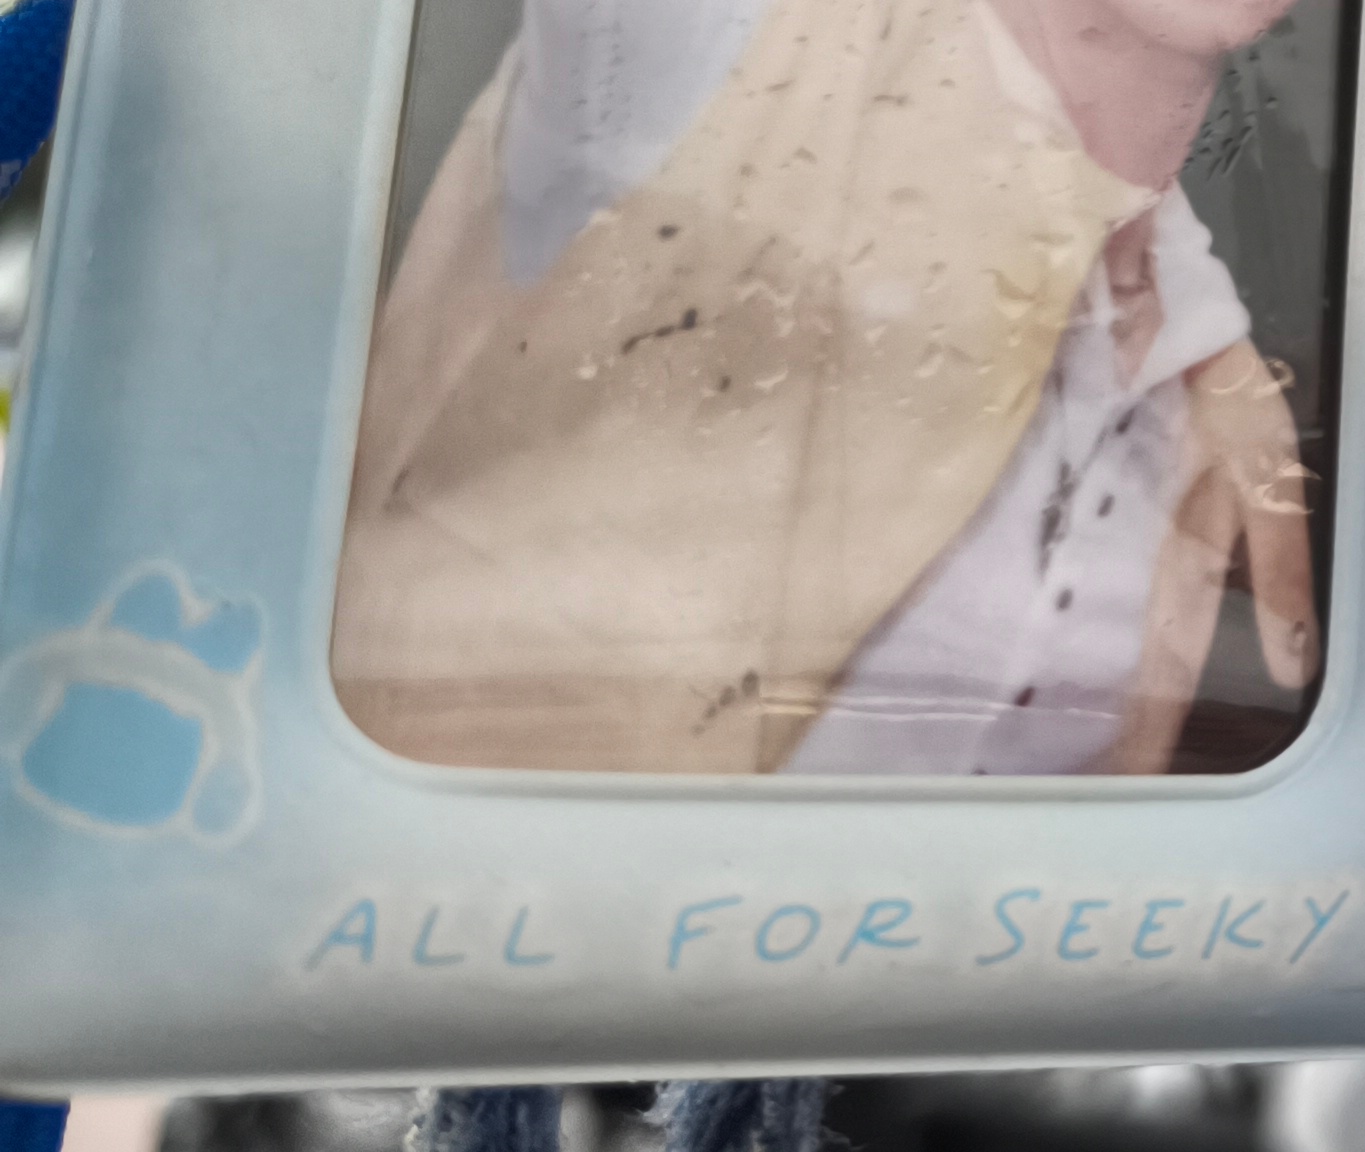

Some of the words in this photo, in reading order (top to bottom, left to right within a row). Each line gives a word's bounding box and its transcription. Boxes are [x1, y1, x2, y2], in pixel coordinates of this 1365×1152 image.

[305, 896, 556, 971] ALL
[664, 894, 923, 970] FOR
[973, 887, 1350, 966] SEEKY
